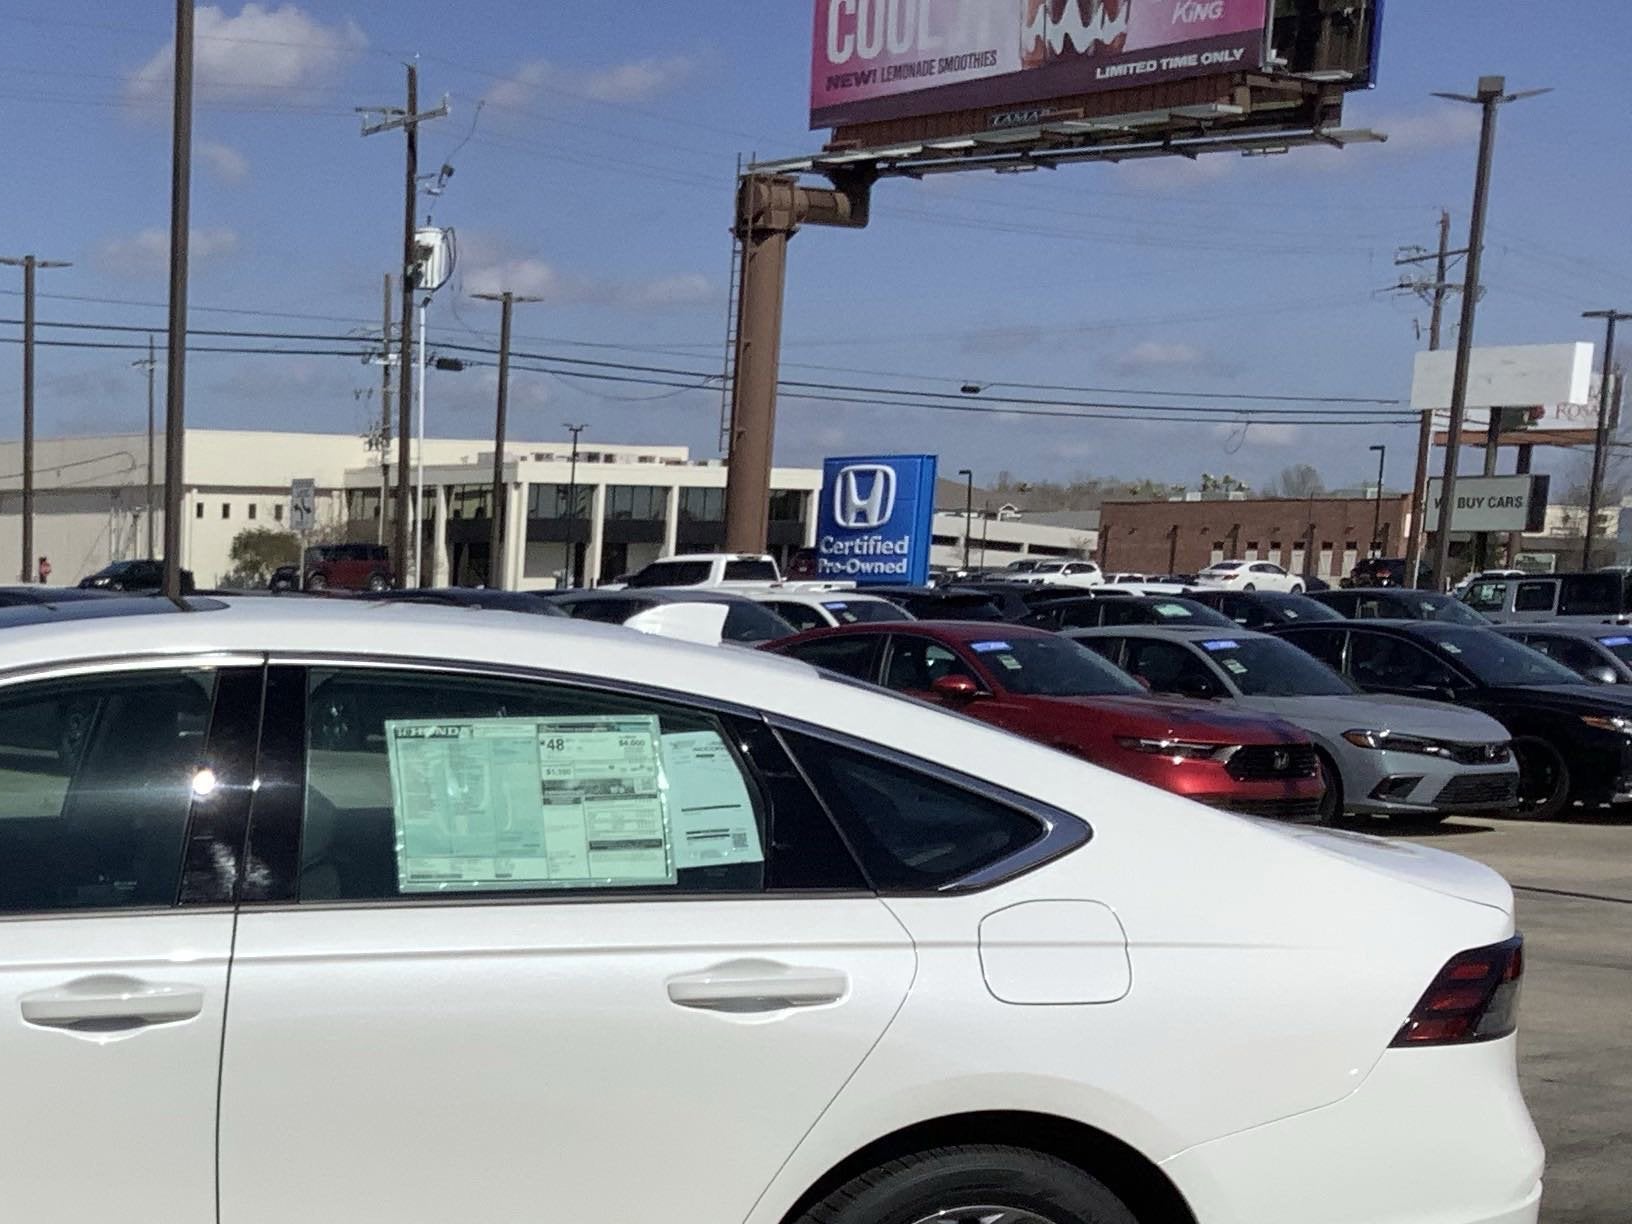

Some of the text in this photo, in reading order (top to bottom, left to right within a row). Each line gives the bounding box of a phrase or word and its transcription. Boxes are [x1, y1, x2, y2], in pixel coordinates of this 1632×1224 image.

[826, 50, 998, 91] NEW! LEMONADE SMOOTHIES
[1095, 48, 1245, 79] LIMITED TIME ONLY
[1457, 497, 1484, 509] BUY
[1487, 496, 1523, 509] CARS
[820, 535, 909, 555] Certified
[818, 558, 908, 574] Pre-Owned
[546, 738, 565, 751] 48
